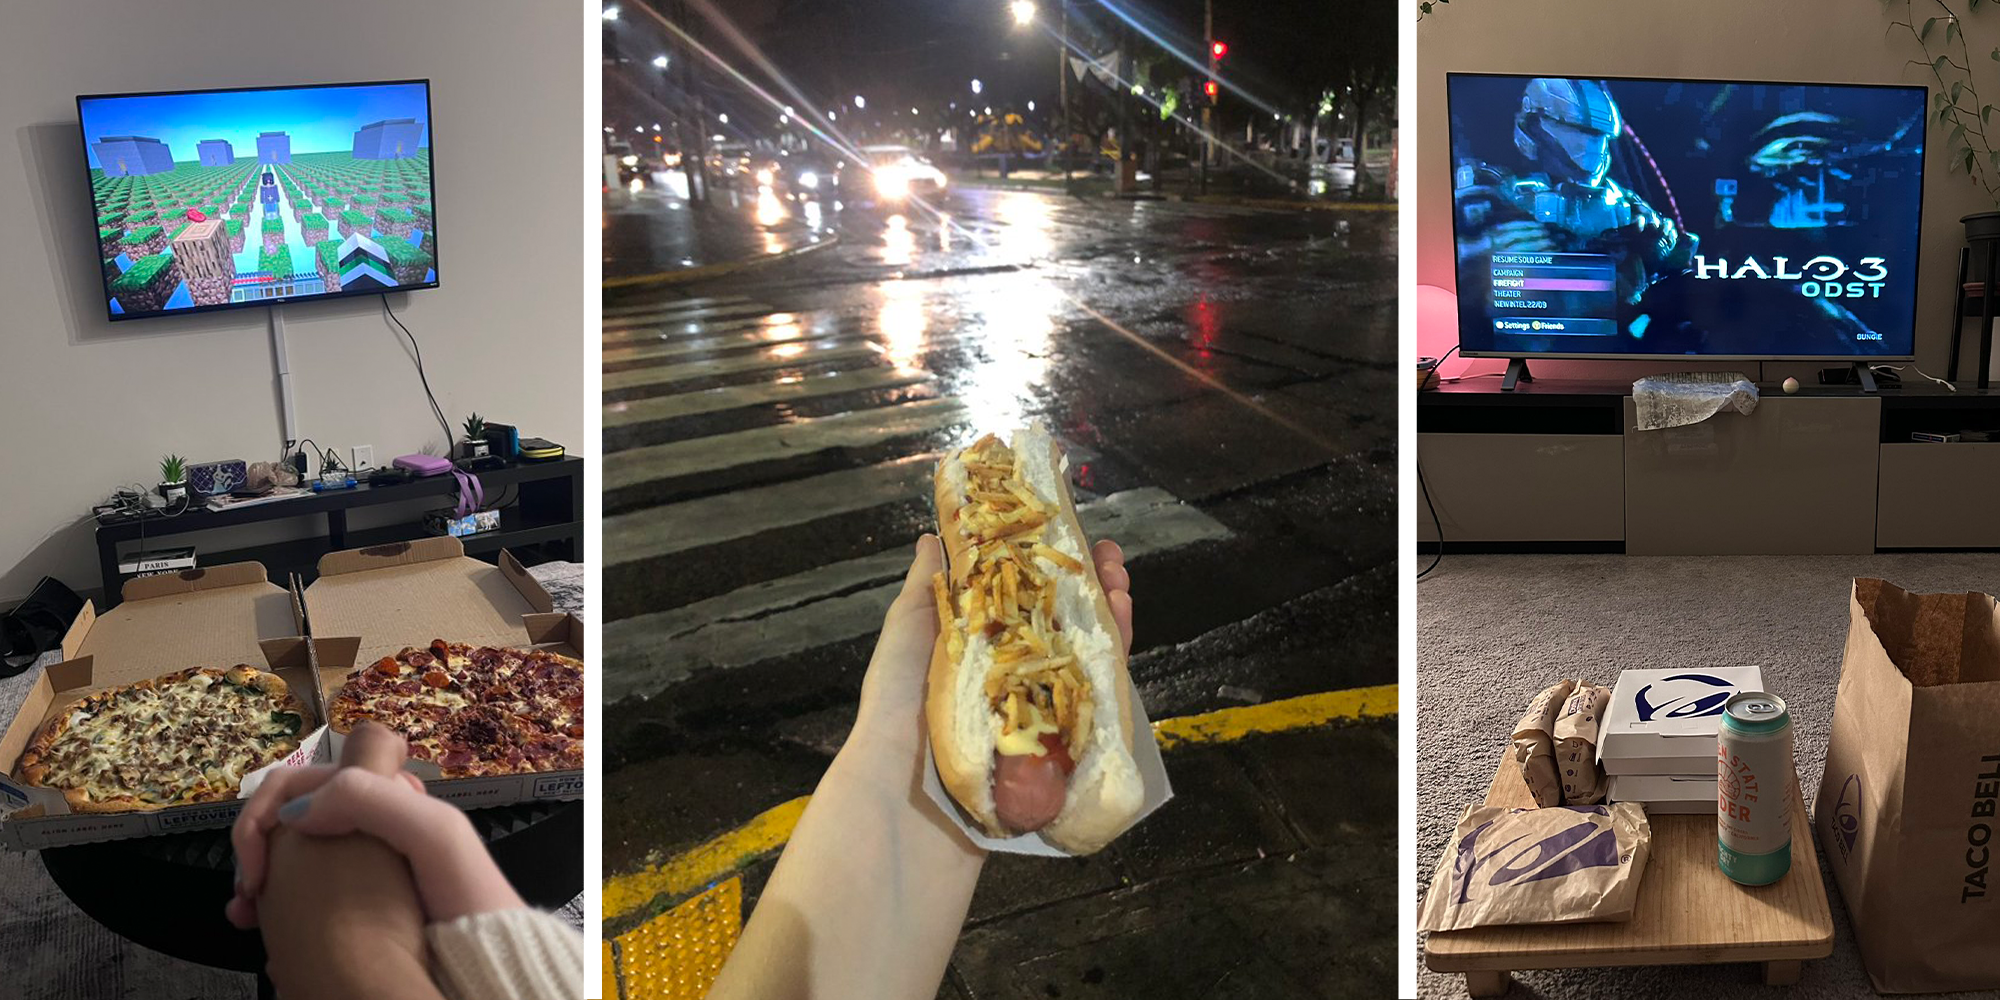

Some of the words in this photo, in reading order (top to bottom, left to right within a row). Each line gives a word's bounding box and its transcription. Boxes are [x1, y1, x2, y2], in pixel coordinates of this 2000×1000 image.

[1492, 255, 1518, 263] RESUME
[1519, 256, 1534, 264] SOLO
[1493, 269, 1524, 277] CAMPAIGN
[1694, 255, 1850, 282] HALO
[1852, 256, 1888, 282] 3
[1493, 279, 1524, 287] FIREFIGHT
[1494, 290, 1521, 298] THEATER
[1801, 281, 1886, 298] ODST
[1504, 321, 1530, 331] Settings
[1541, 321, 1565, 330] Friends
[1856, 333, 1883, 341] BUNGIE
[144, 561, 169, 570] PARIS
[1730, 755, 1759, 803] STATE
[1961, 823, 1992, 904] TACO
